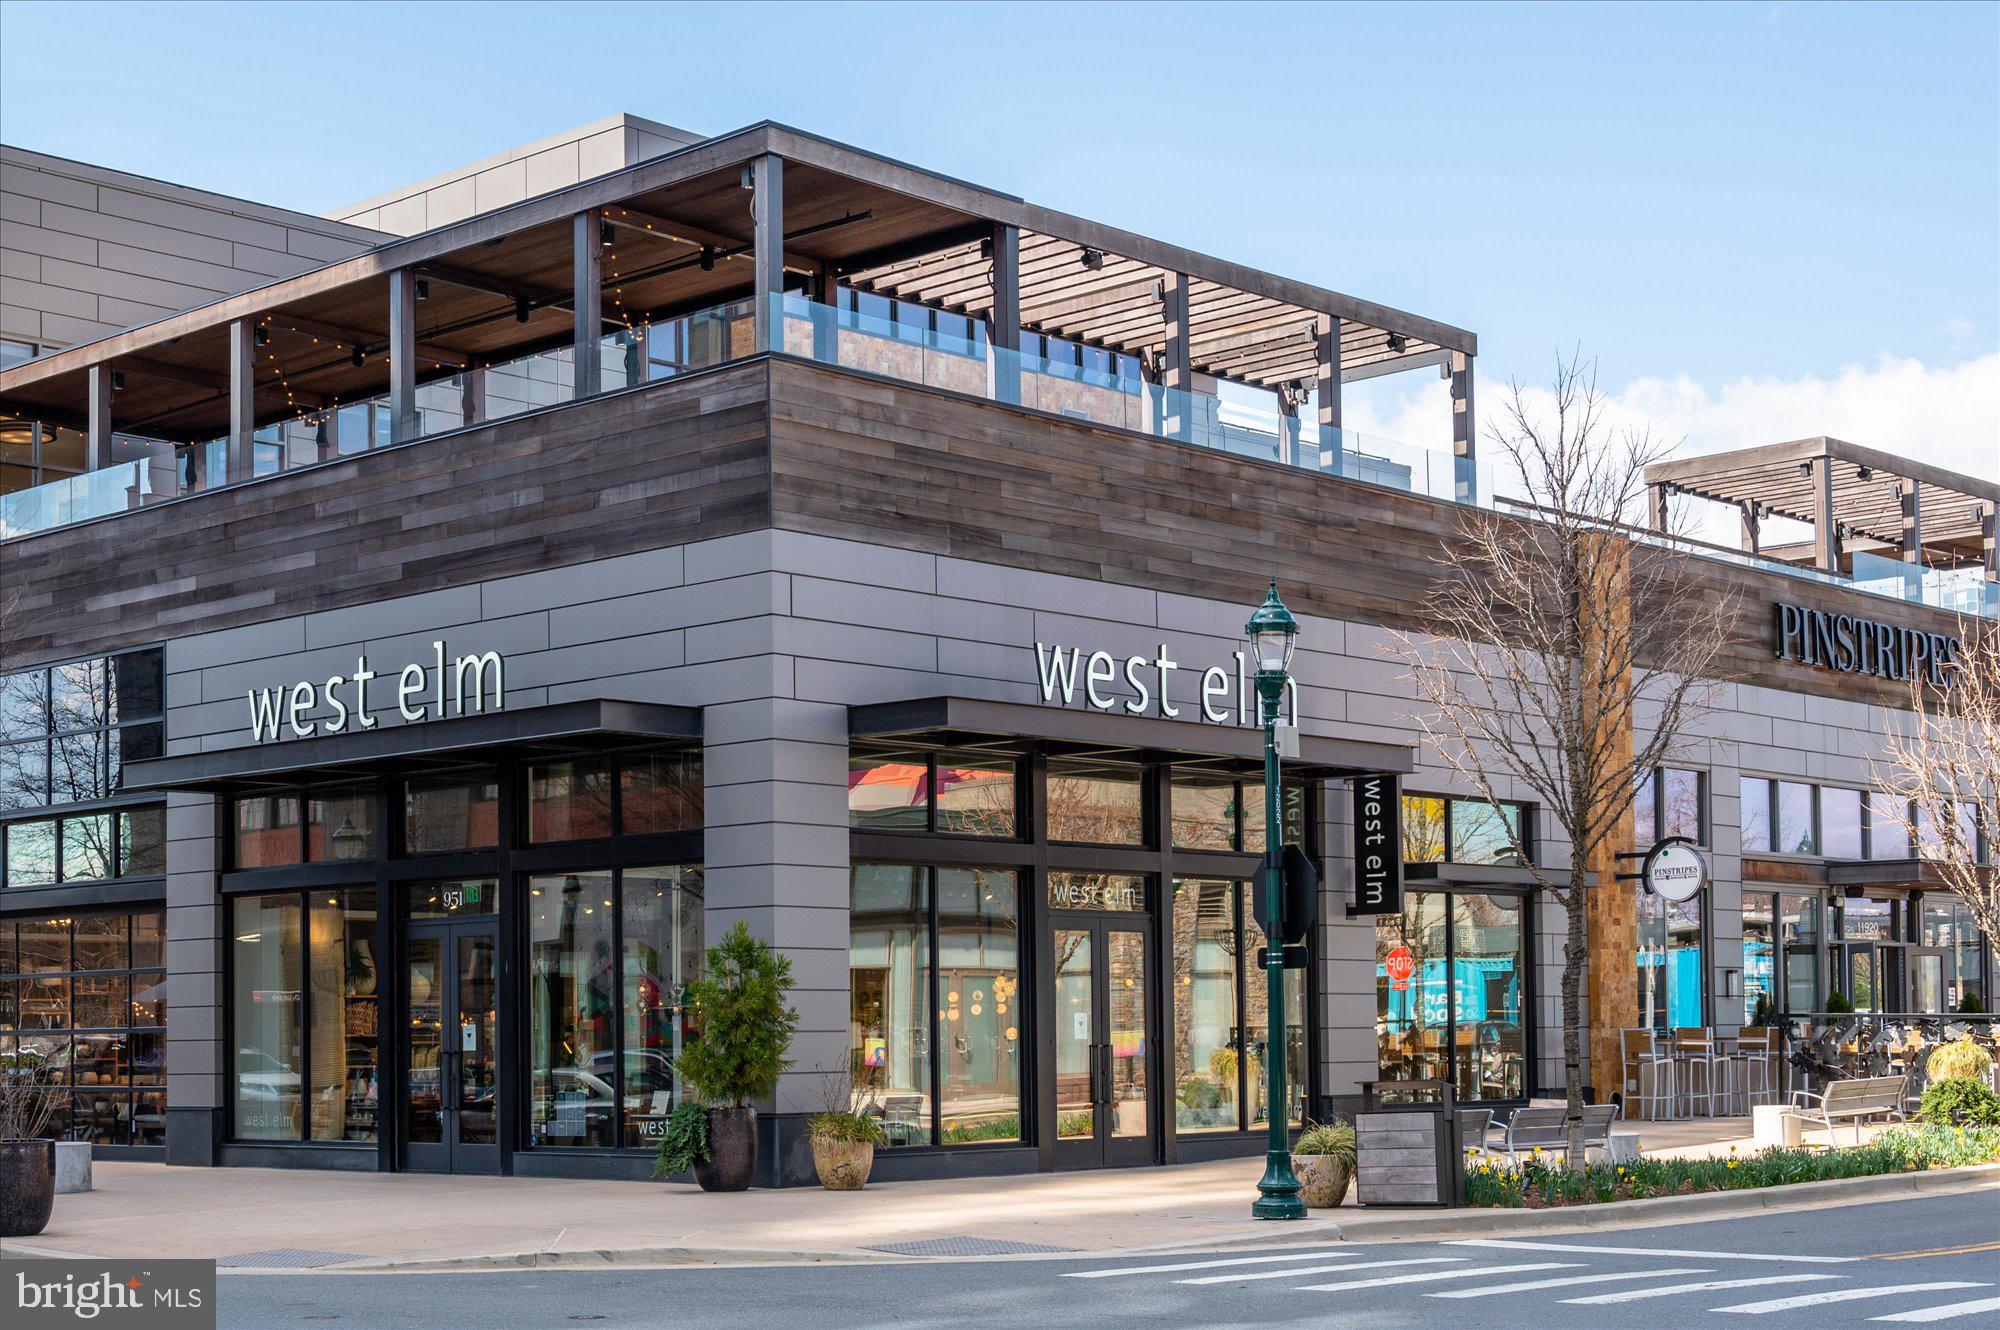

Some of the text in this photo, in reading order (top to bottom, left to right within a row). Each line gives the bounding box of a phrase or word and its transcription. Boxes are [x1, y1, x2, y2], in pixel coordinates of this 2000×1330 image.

[1775, 603, 1965, 691] PINSTRIPES
[1034, 642, 1178, 717] west
[248, 640, 504, 741] west elm
[1364, 779, 1387, 904] west elm
[1654, 866, 1698, 876] PINSTRIPES
[443, 891, 463, 907] 951
[1055, 882, 1136, 905] west elm
[1857, 921, 1879, 933] 11920
[244, 1111, 293, 1128] west elm
[637, 1118, 670, 1136] west
